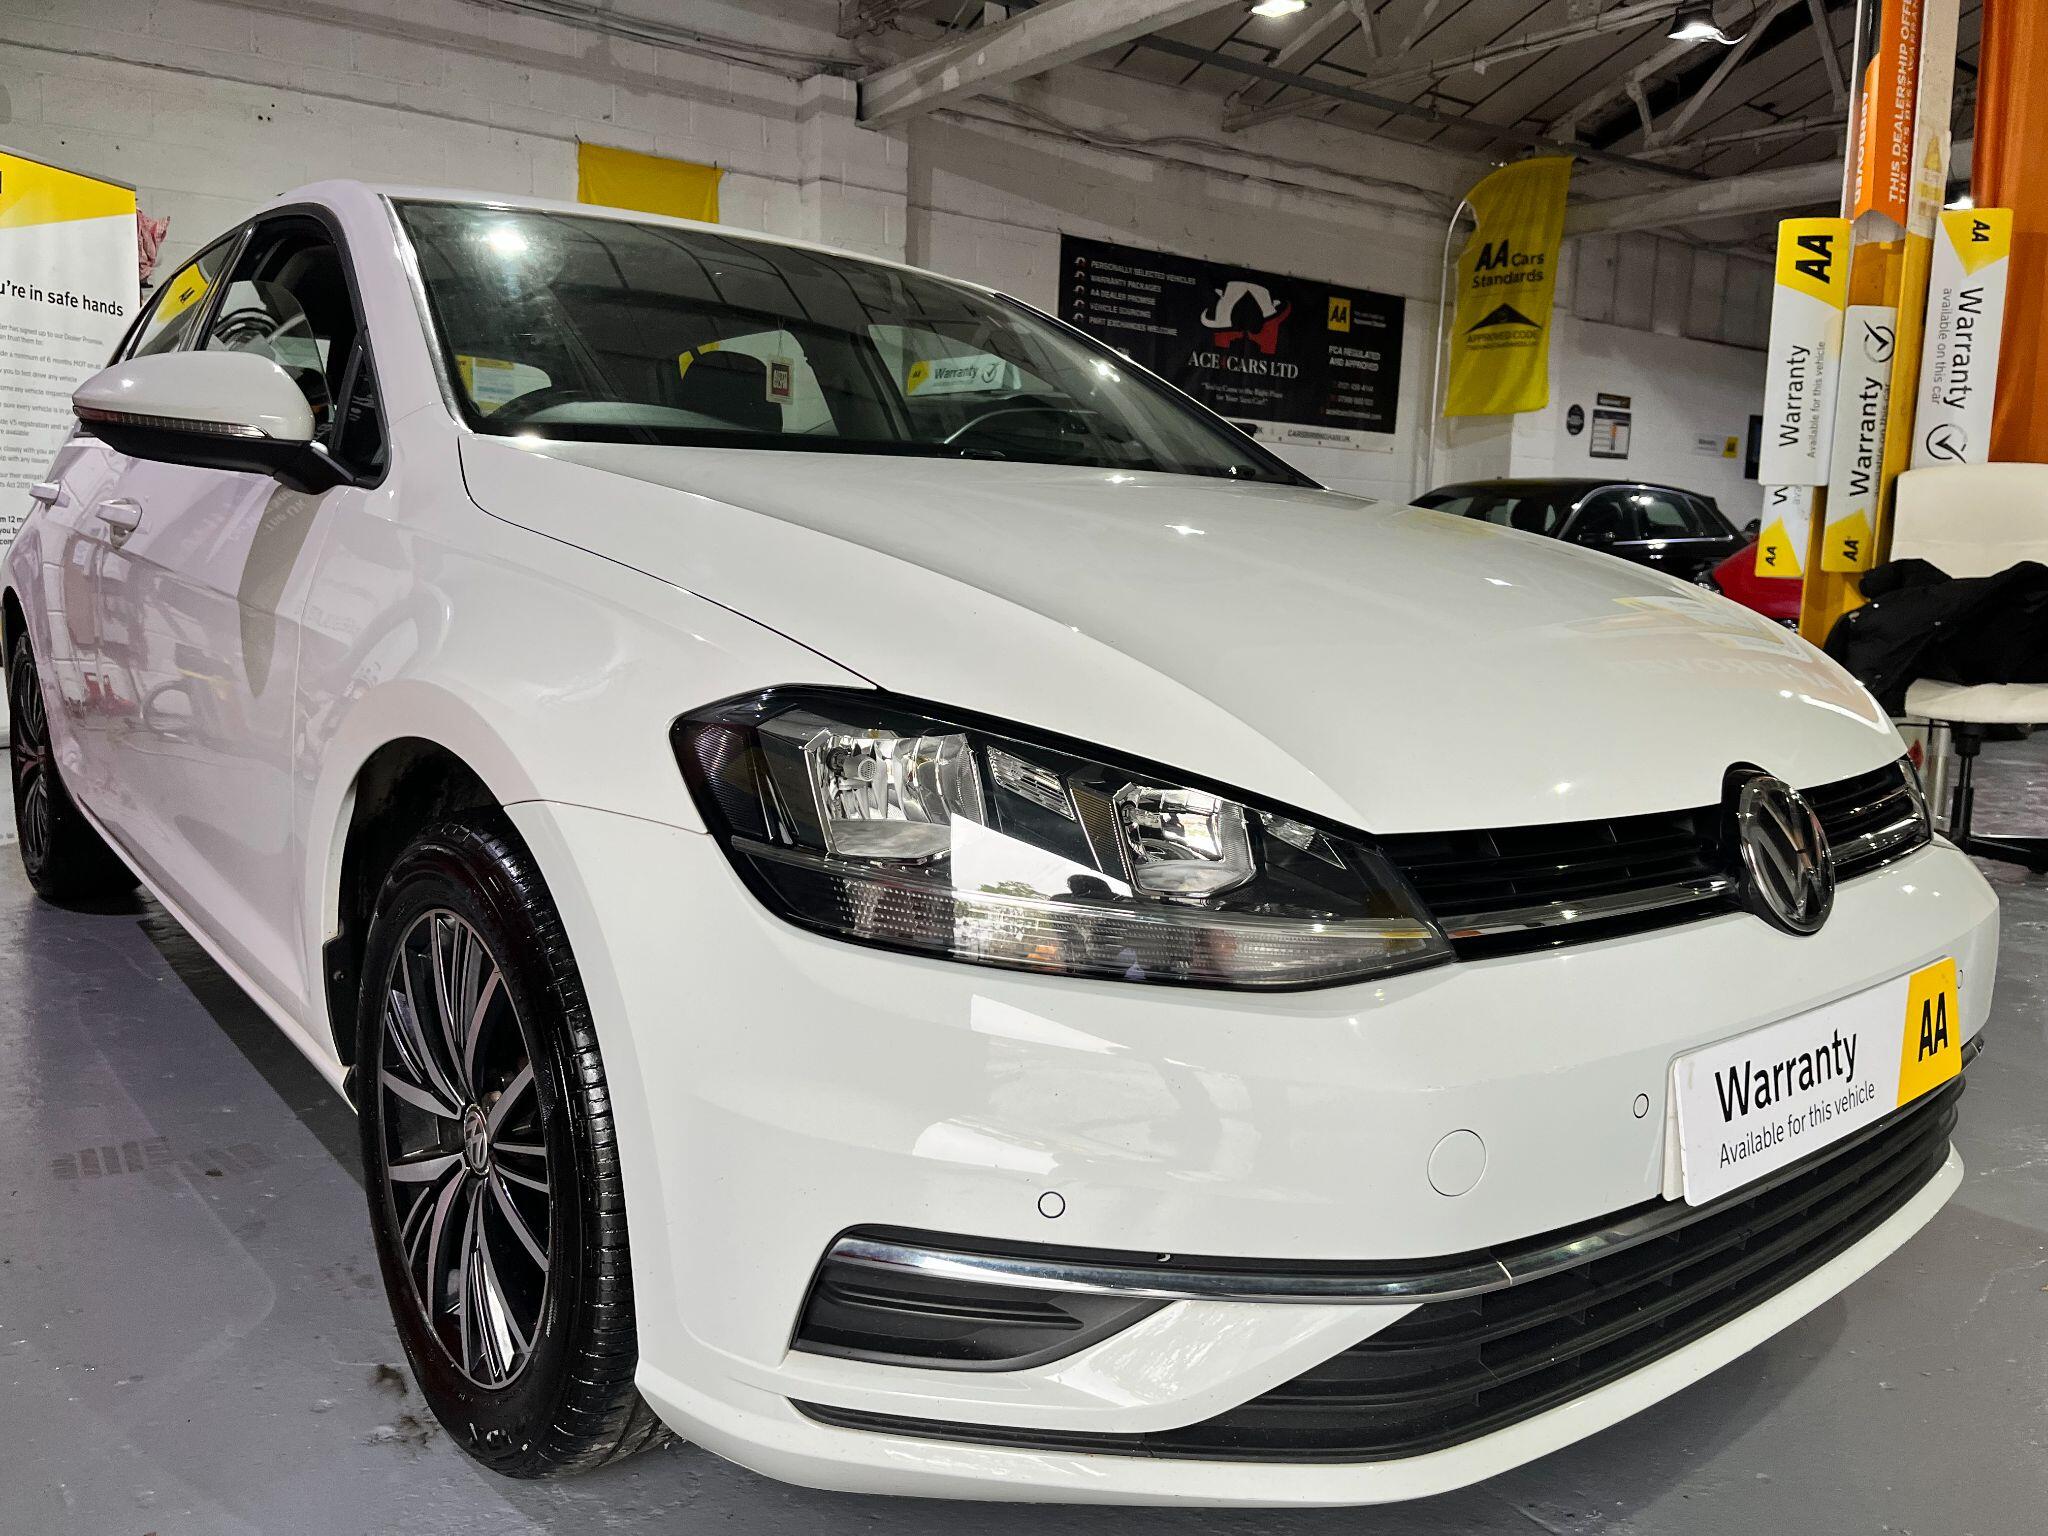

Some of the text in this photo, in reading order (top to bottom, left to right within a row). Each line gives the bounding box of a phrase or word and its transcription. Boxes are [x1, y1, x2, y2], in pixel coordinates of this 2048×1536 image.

[1892, 43, 1908, 157] DEALERSHIP
[1902, 126, 1910, 166] UK'S
[1889, 160, 1900, 203] THIS
[1899, 171, 1907, 204] THE
[1972, 219, 1991, 243] AA
[1475, 239, 1545, 272] AA Cars
[1795, 234, 1834, 285] AA
[1472, 269, 1544, 289] Standards
[30, 285, 43, 301] in
[48, 292, 79, 308] safe
[83, 295, 124, 317] hands
[1331, 304, 1347, 324] AA
[1188, 350, 1220, 369] ACE
[1226, 356, 1268, 375] CARS
[1270, 361, 1299, 379] LTD
[1931, 288, 1952, 404] available on this car
[1943, 287, 1984, 409] Warranty
[935, 365, 978, 379] Warranty
[1778, 344, 1811, 447] Warranty
[1806, 341, 1826, 458] Available for this vehicle
[1849, 376, 1883, 497] Warranty
[1765, 546, 1777, 566] AA
[1843, 539, 1859, 562] AA
[1715, 991, 1949, 1122] Warranty AA
[1720, 1080, 1875, 1169] Available for this vehicle
